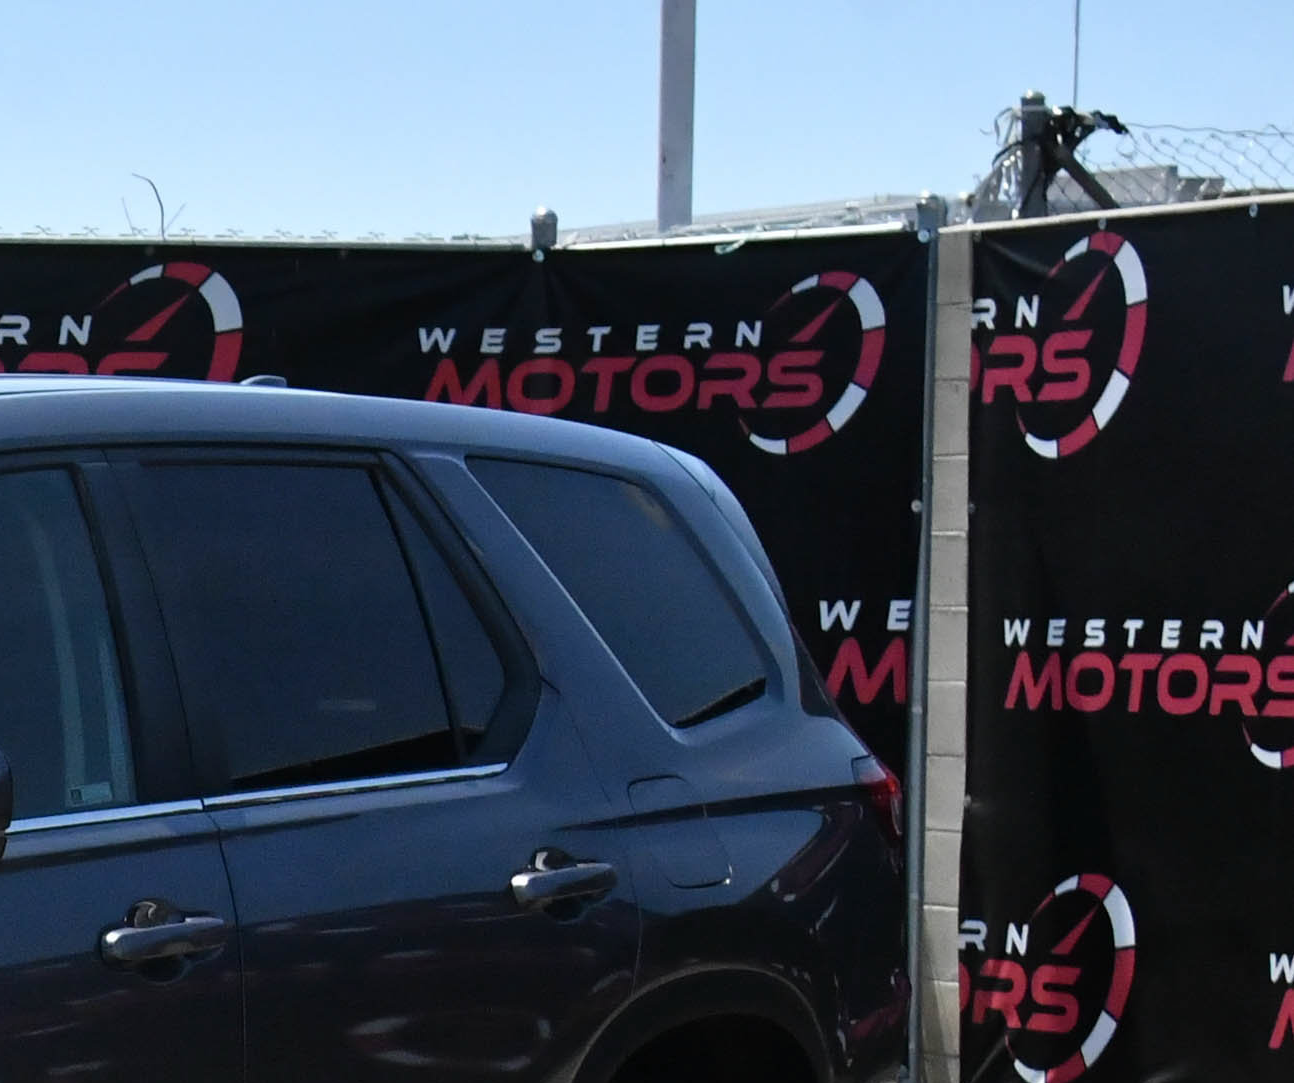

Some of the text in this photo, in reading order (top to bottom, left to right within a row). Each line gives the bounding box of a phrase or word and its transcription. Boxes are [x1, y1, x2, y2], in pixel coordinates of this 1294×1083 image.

[419, 321, 762, 353] WESTERN
[426, 351, 824, 414] MOTORS
[1003, 618, 1265, 650] WESTERN
[1004, 651, 1294, 719] MOTORS
